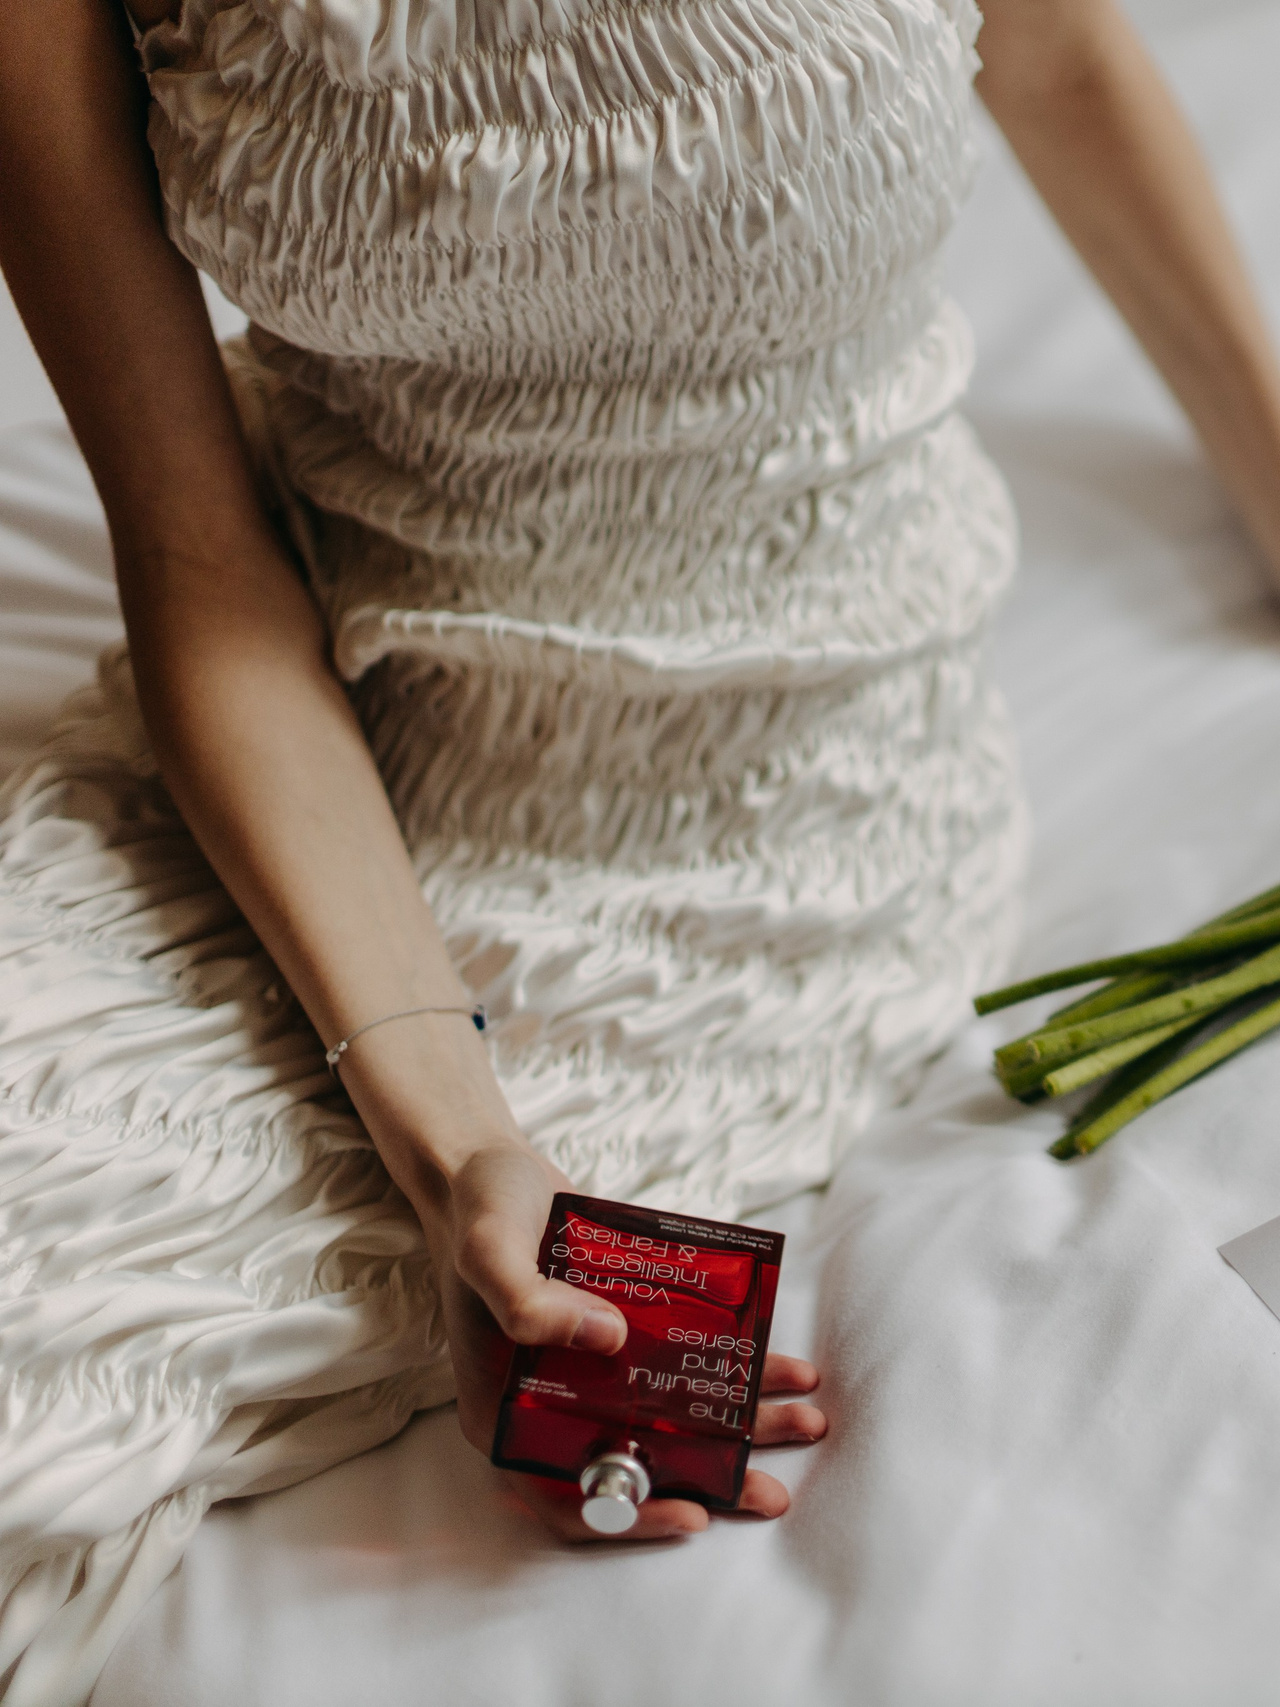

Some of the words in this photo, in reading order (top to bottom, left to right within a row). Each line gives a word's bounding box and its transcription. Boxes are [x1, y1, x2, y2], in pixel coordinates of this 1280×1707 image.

[556, 1218, 669, 1258] Fantasy
[677, 1244, 698, 1263] &
[551, 1243, 710, 1290] Intelligence
[565, 1268, 671, 1305] Volume
[668, 1327, 757, 1356] Series
[681, 1352, 753, 1382] Mind
[628, 1366, 749, 1404] Beautiful
[689, 1402, 744, 1429] The
